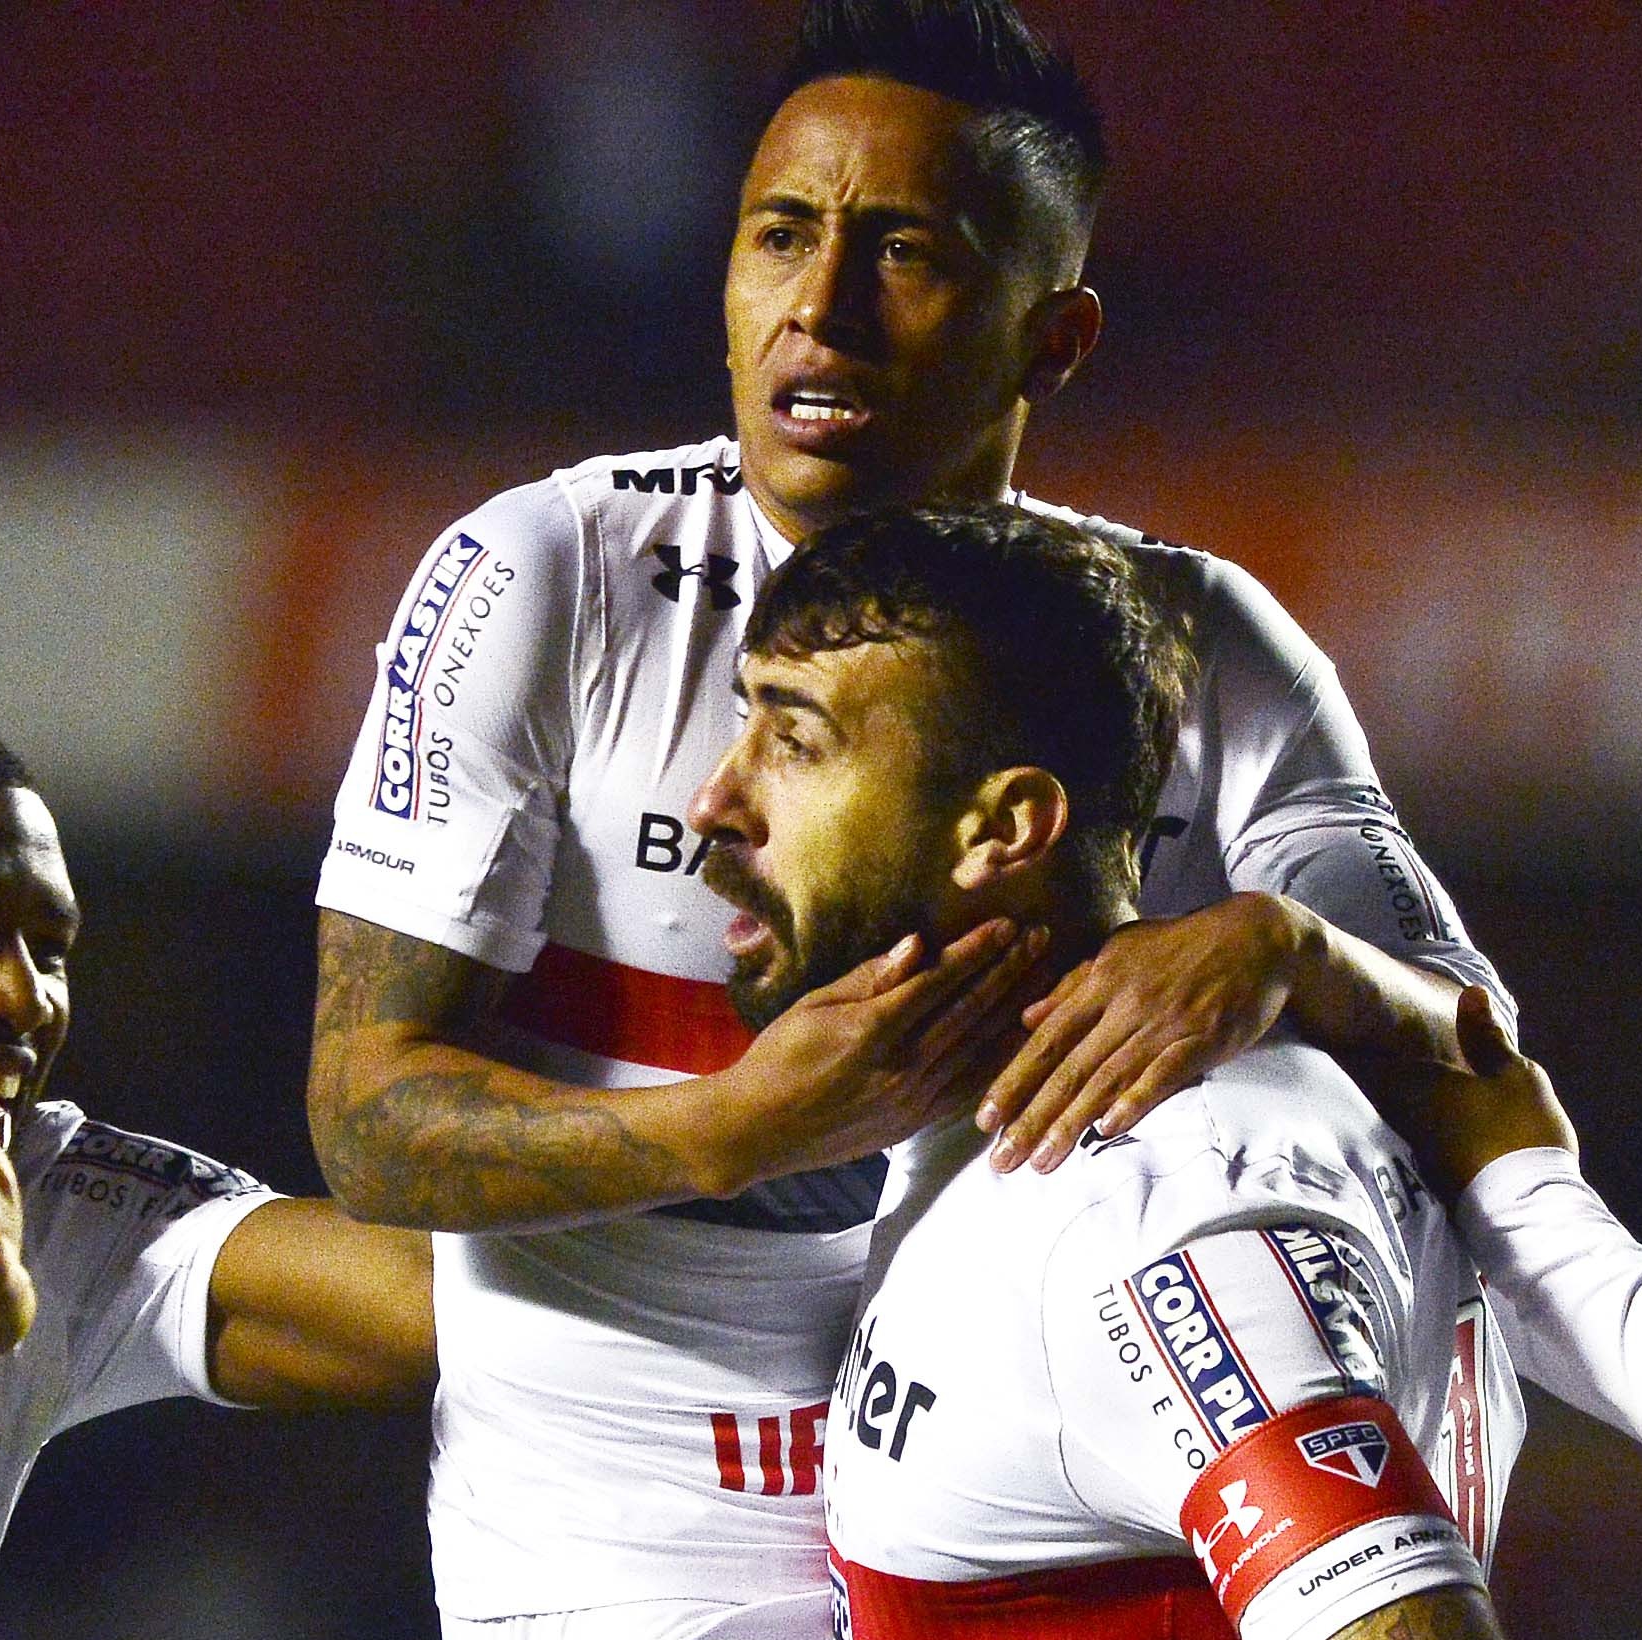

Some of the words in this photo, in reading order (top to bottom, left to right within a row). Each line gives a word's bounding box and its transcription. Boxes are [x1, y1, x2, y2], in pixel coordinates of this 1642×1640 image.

[389, 538, 480, 690] LASTIK
[380, 686, 413, 814] CORR
[427, 731, 453, 824] TUBOS
[1093, 1283, 1153, 1383] TUBOS
[1152, 1395, 1174, 1416] E
[1141, 1262, 1223, 1383] CORR
[1199, 1372, 1263, 1440] PL
[1308, 1424, 1379, 1455] SPFC
[1230, 1516, 1295, 1576] ARMOUR
[1298, 1544, 1385, 1598] UNDER
